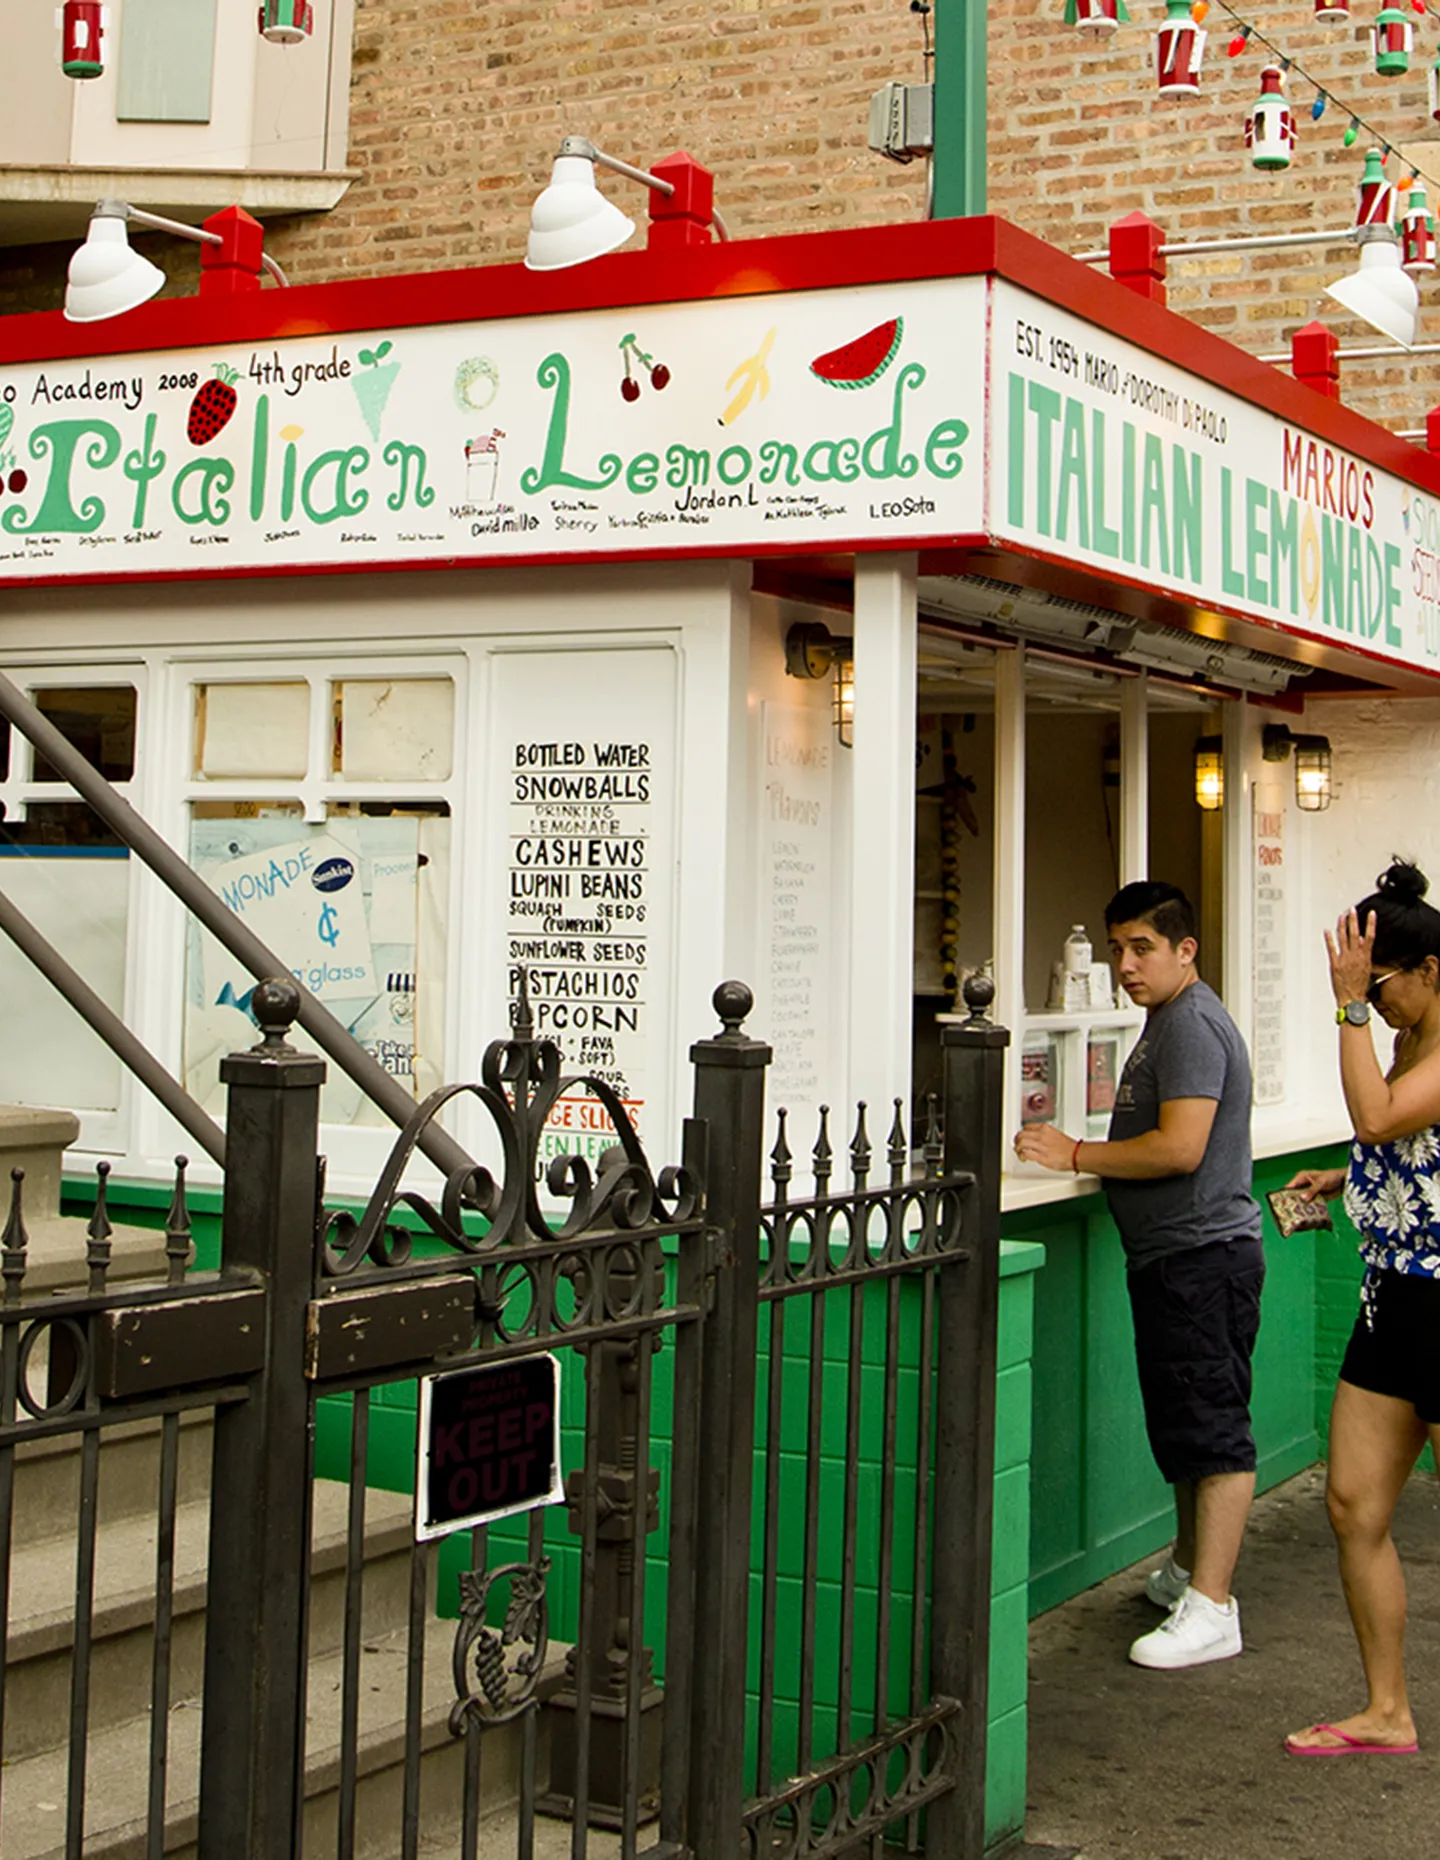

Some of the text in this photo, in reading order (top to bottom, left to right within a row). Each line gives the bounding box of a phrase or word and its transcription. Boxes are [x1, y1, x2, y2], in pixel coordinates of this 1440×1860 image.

[1016, 319, 1043, 363] EST.
[1049, 336, 1078, 378] 1954
[1085, 352, 1118, 395] MARIO
[31, 373, 143, 410] Academy
[158, 372, 199, 391] 2008
[249, 352, 289, 385] 4th
[291, 346, 351, 396] grade
[1, 393, 436, 535] Italian
[520, 352, 971, 496] Lemonade
[1283, 428, 1375, 529] MARIOS
[1008, 371, 1402, 648] ITALIAN LEMONADE
[515, 743, 650, 767] BOTTLED WATER
[515, 774, 650, 801] SNOWBALLS
[535, 805, 614, 819] DRINKING
[530, 820, 620, 835] LEMONADE
[516, 838, 644, 867] CASHEWS
[312, 864, 354, 886] Sunkist
[511, 872, 642, 899] LUPINI BEANS
[509, 901, 646, 922] SQUASH SEEDS
[542, 916, 611, 934] (PUMPKIN)
[509, 940, 646, 965] SUNFLOWER SEEDS
[308, 962, 366, 993] glass
[509, 969, 639, 999] PSTACHIOS
[509, 1002, 637, 1031] PPCORN
[581, 1036, 614, 1050] FAVA
[469, 1371, 521, 1393] PRIVATE
[435, 1402, 550, 1468] KEEP
[448, 1451, 536, 1511] OUT
